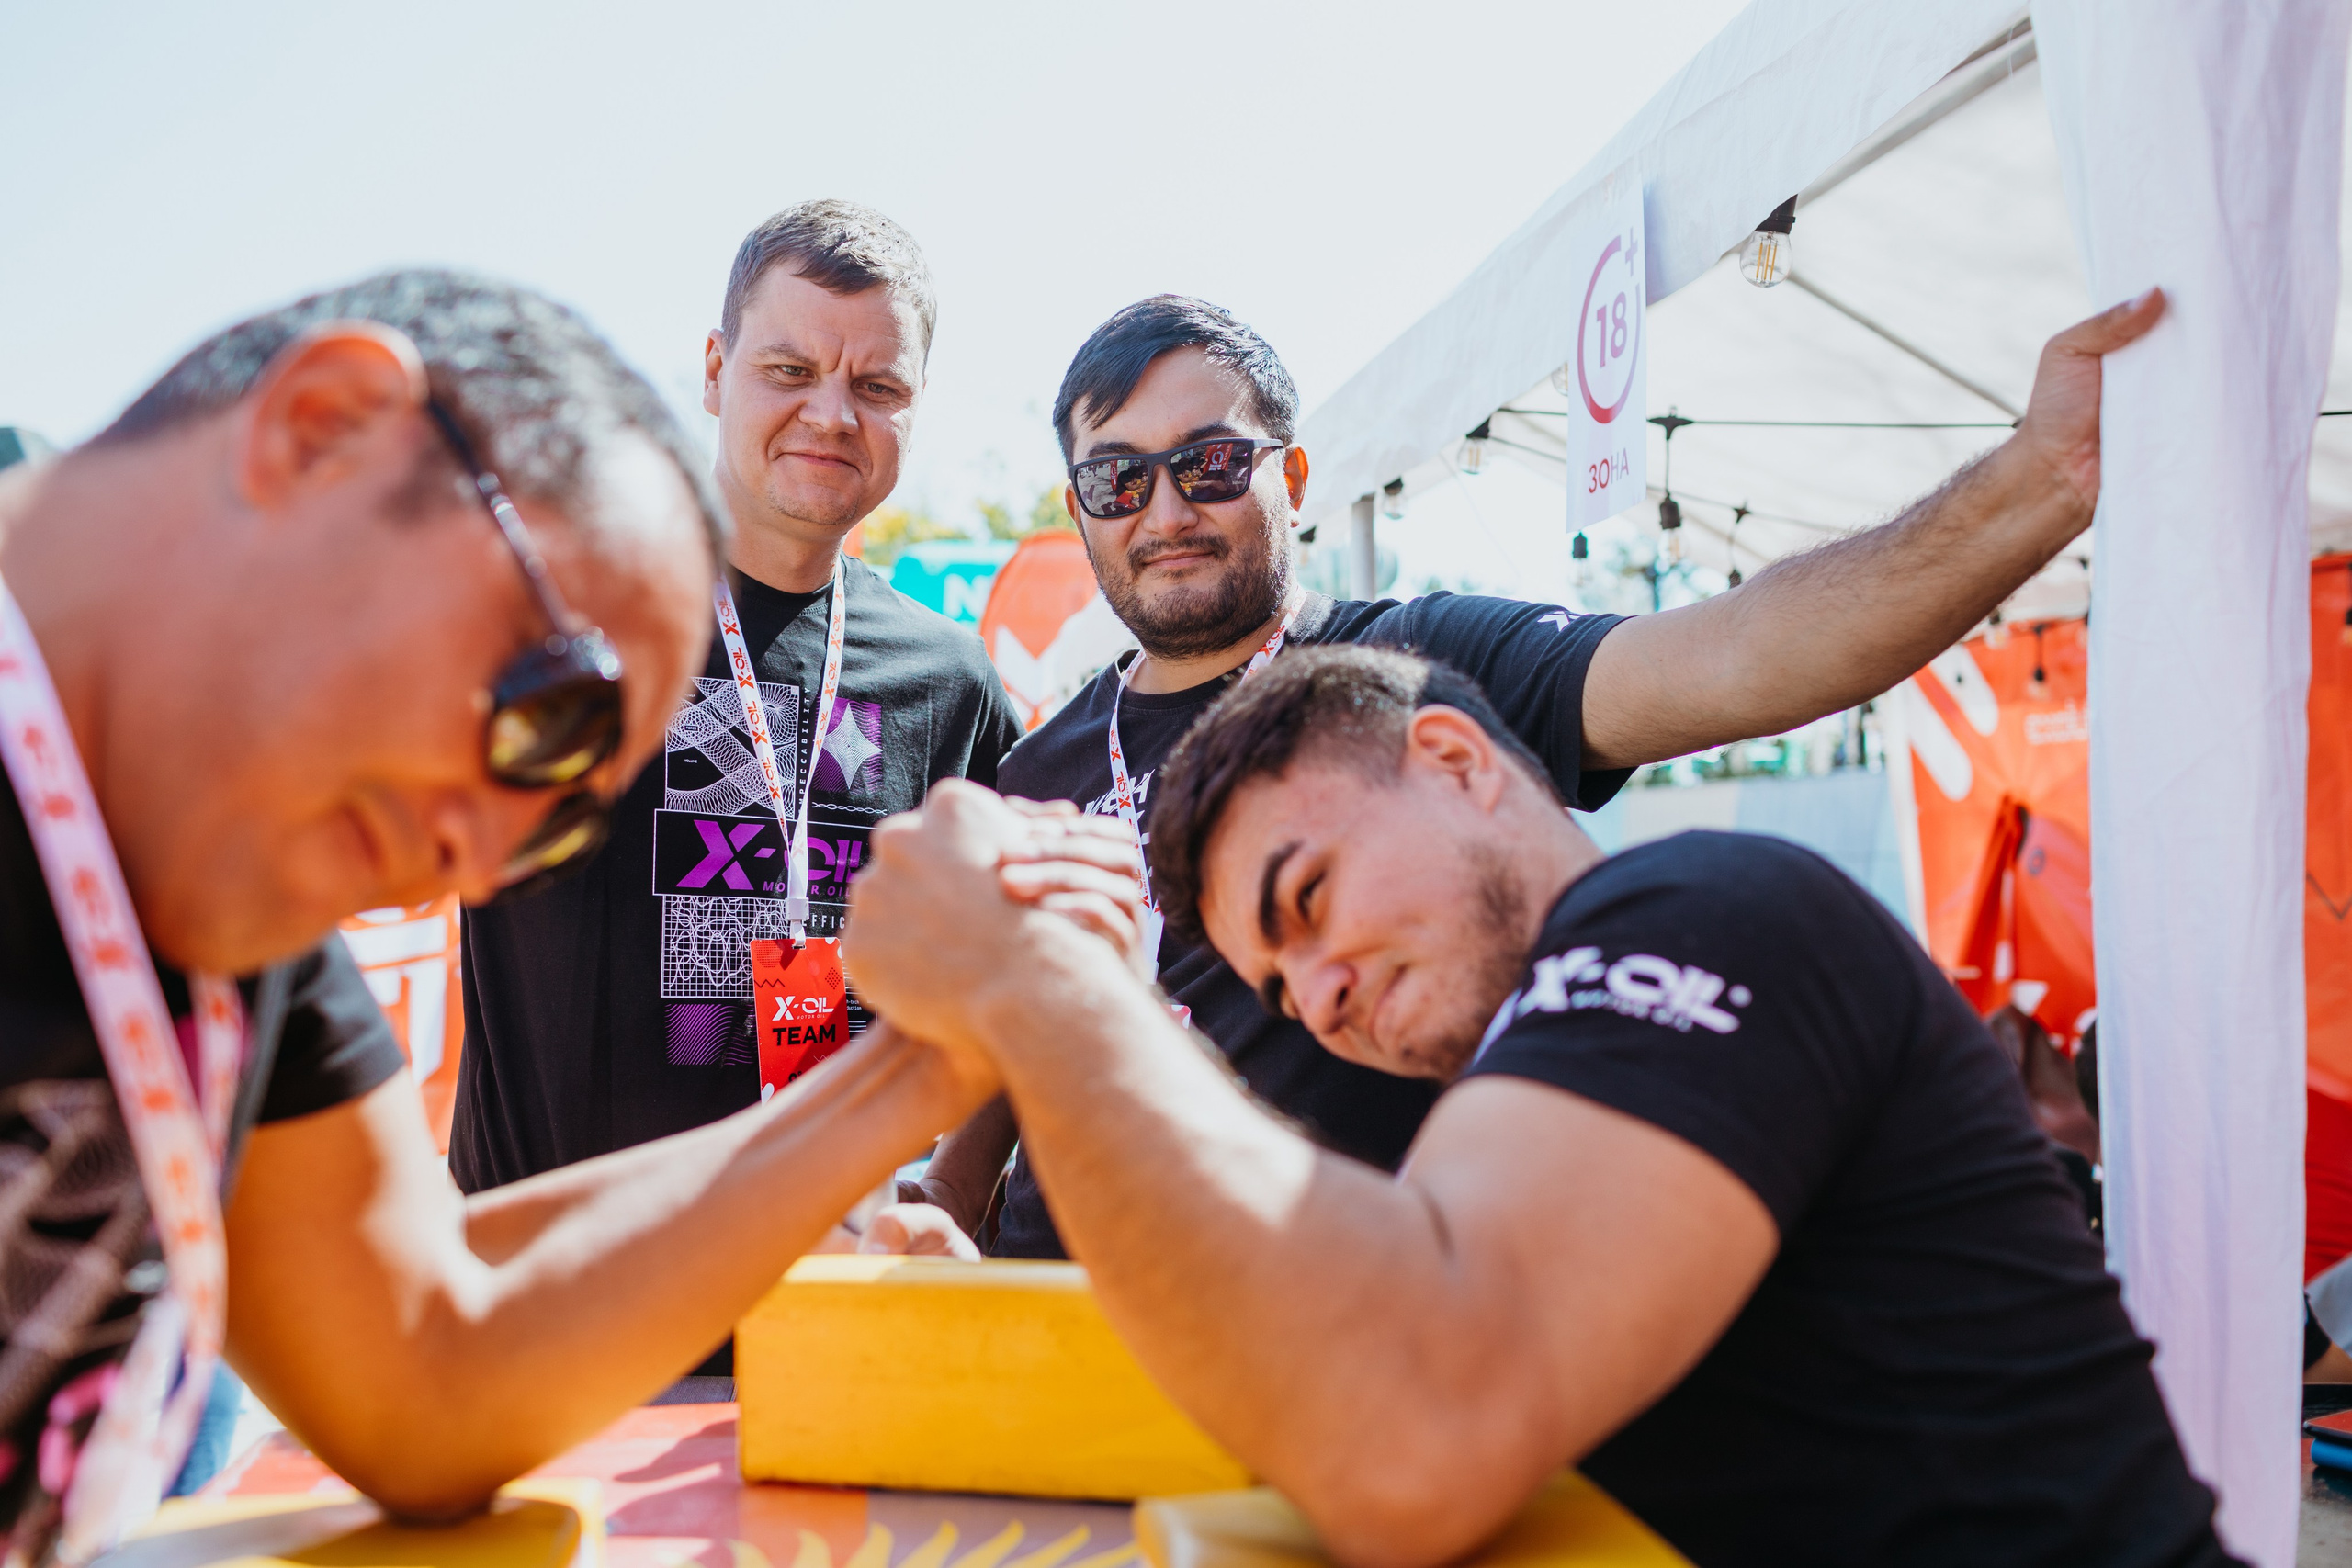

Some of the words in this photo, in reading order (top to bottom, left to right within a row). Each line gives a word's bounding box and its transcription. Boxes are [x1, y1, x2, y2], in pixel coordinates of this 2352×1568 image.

[1589, 447, 1630, 494] ЗОНА
[732, 646, 754, 689] X-OIL
[746, 701, 769, 745] X-OIL
[798, 687, 811, 814] MPECCABILITY
[763, 881, 820, 895] MOR
[772, 996, 834, 1021] X-OIL
[772, 1024, 836, 1046] TEAM
